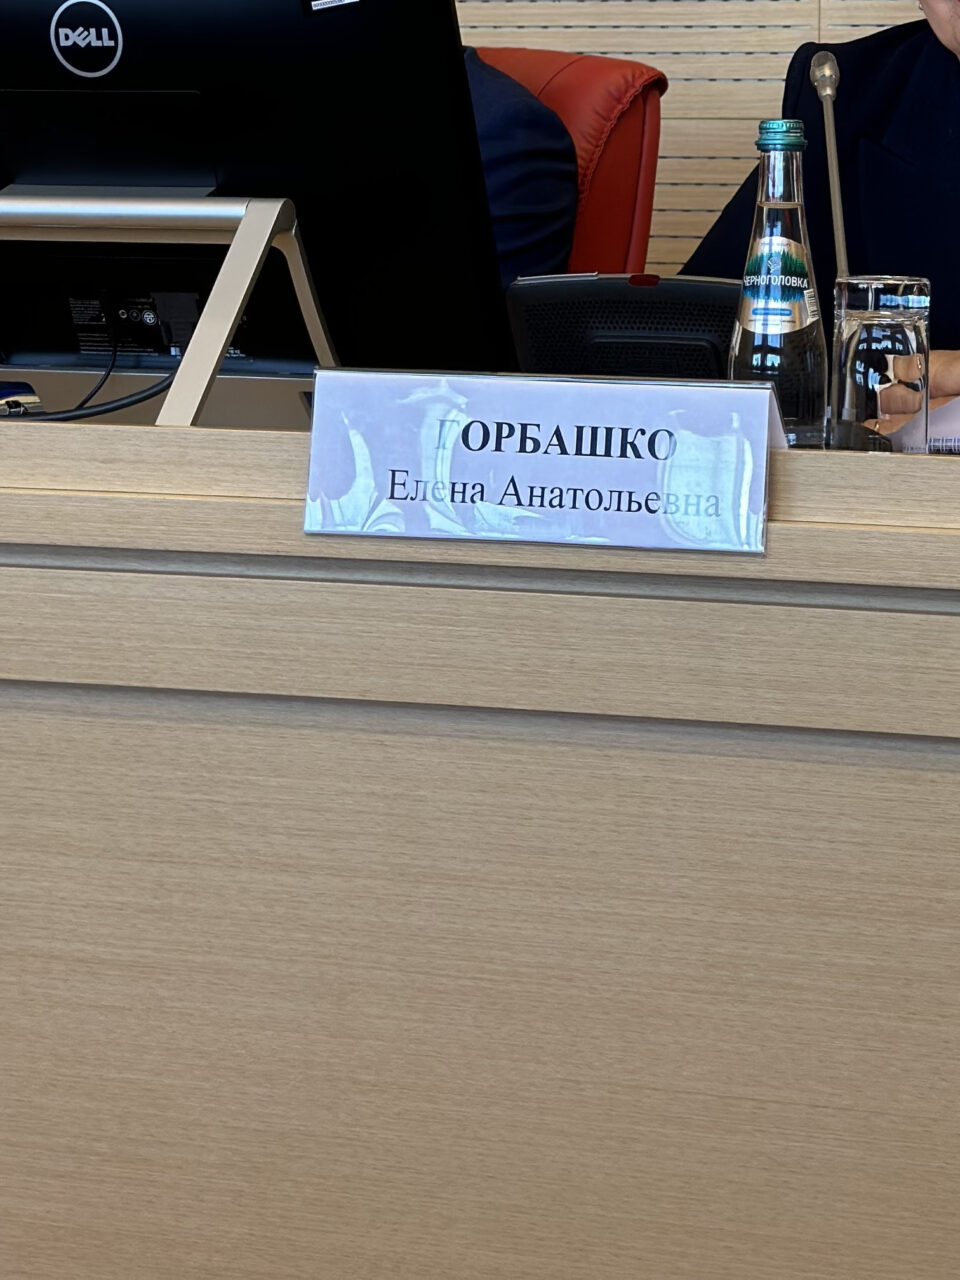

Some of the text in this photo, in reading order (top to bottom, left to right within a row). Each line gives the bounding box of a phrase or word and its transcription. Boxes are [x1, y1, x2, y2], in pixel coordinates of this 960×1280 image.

[58, 26, 115, 48] DELL
[743, 275, 809, 289] ЧЕРНОГОЛОВКА
[434, 419, 678, 461] ГОРБАШКО
[387, 468, 721, 518] Елена Анатольевна
